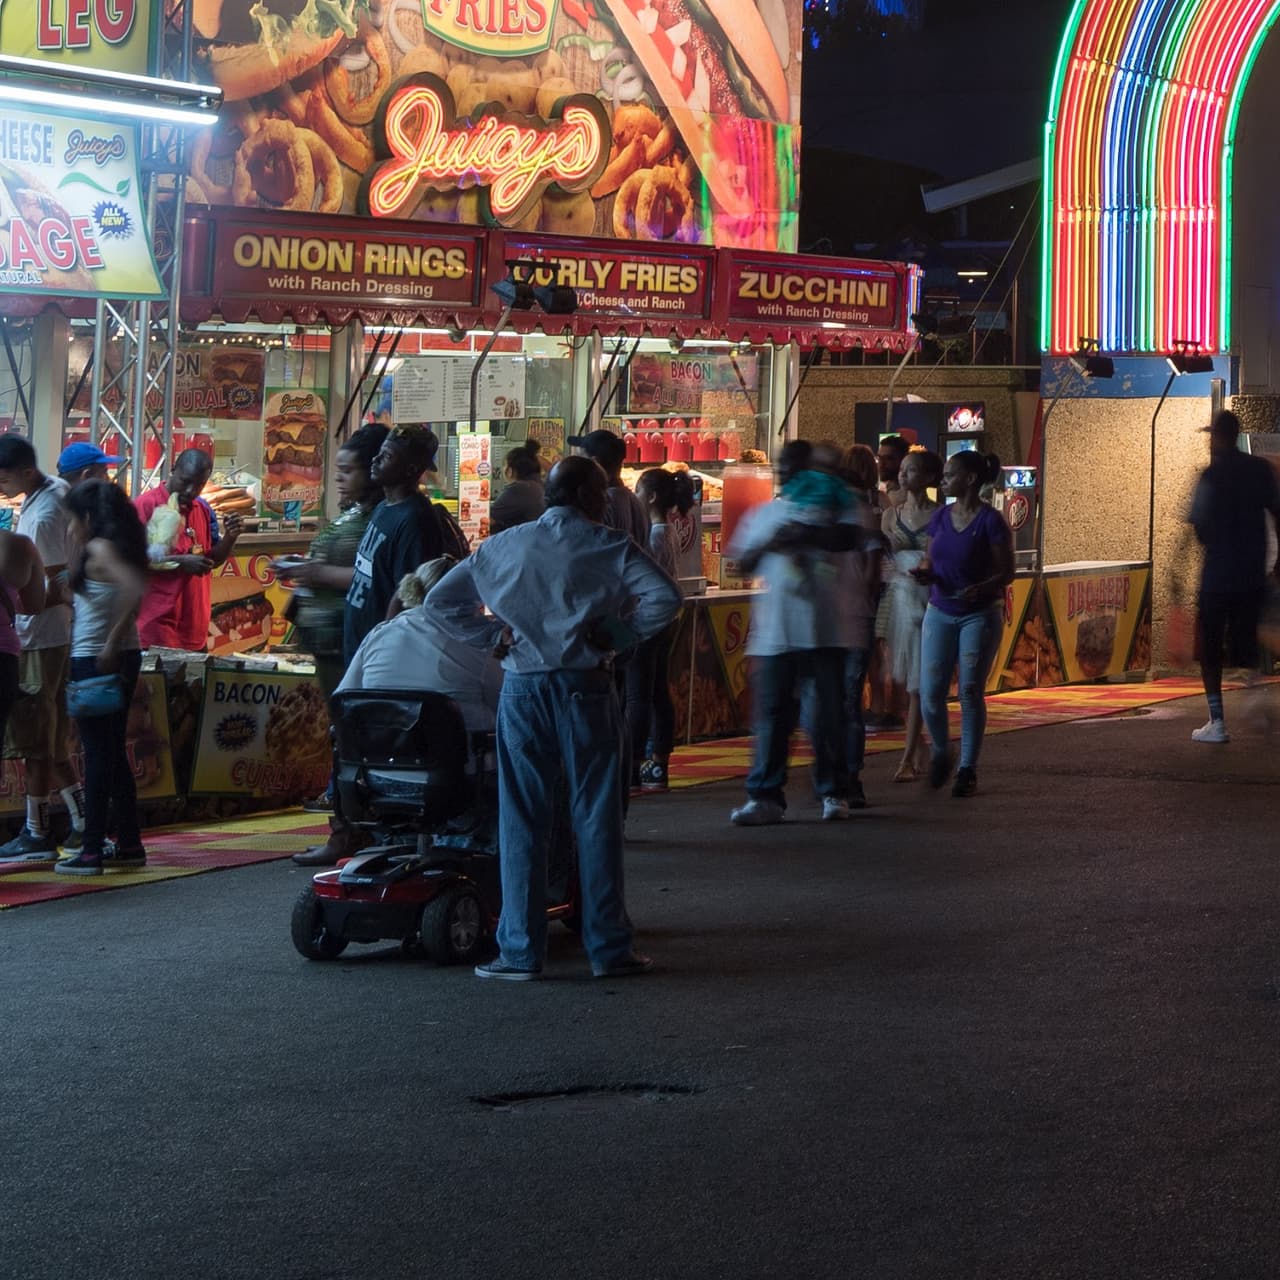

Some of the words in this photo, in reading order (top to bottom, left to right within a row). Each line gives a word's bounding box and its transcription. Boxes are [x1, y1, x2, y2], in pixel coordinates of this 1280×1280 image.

[103, 207, 121, 217] ALL
[232, 233, 354, 274] ONION
[363, 243, 467, 279] RINGS
[267, 274, 305, 291] with
[310, 276, 361, 293] Ranch
[365, 279, 434, 299] Dressing
[619, 262, 699, 295] FRIES
[737, 271, 889, 308] ZUCCHINI
[627, 296, 648, 309] and
[652, 297, 686, 310] Ranch
[757, 303, 783, 317] with
[786, 304, 820, 319] Ranch
[823, 307, 869, 323] Dressing
[671, 359, 712, 382] BACON
[214, 681, 281, 706] BACON
